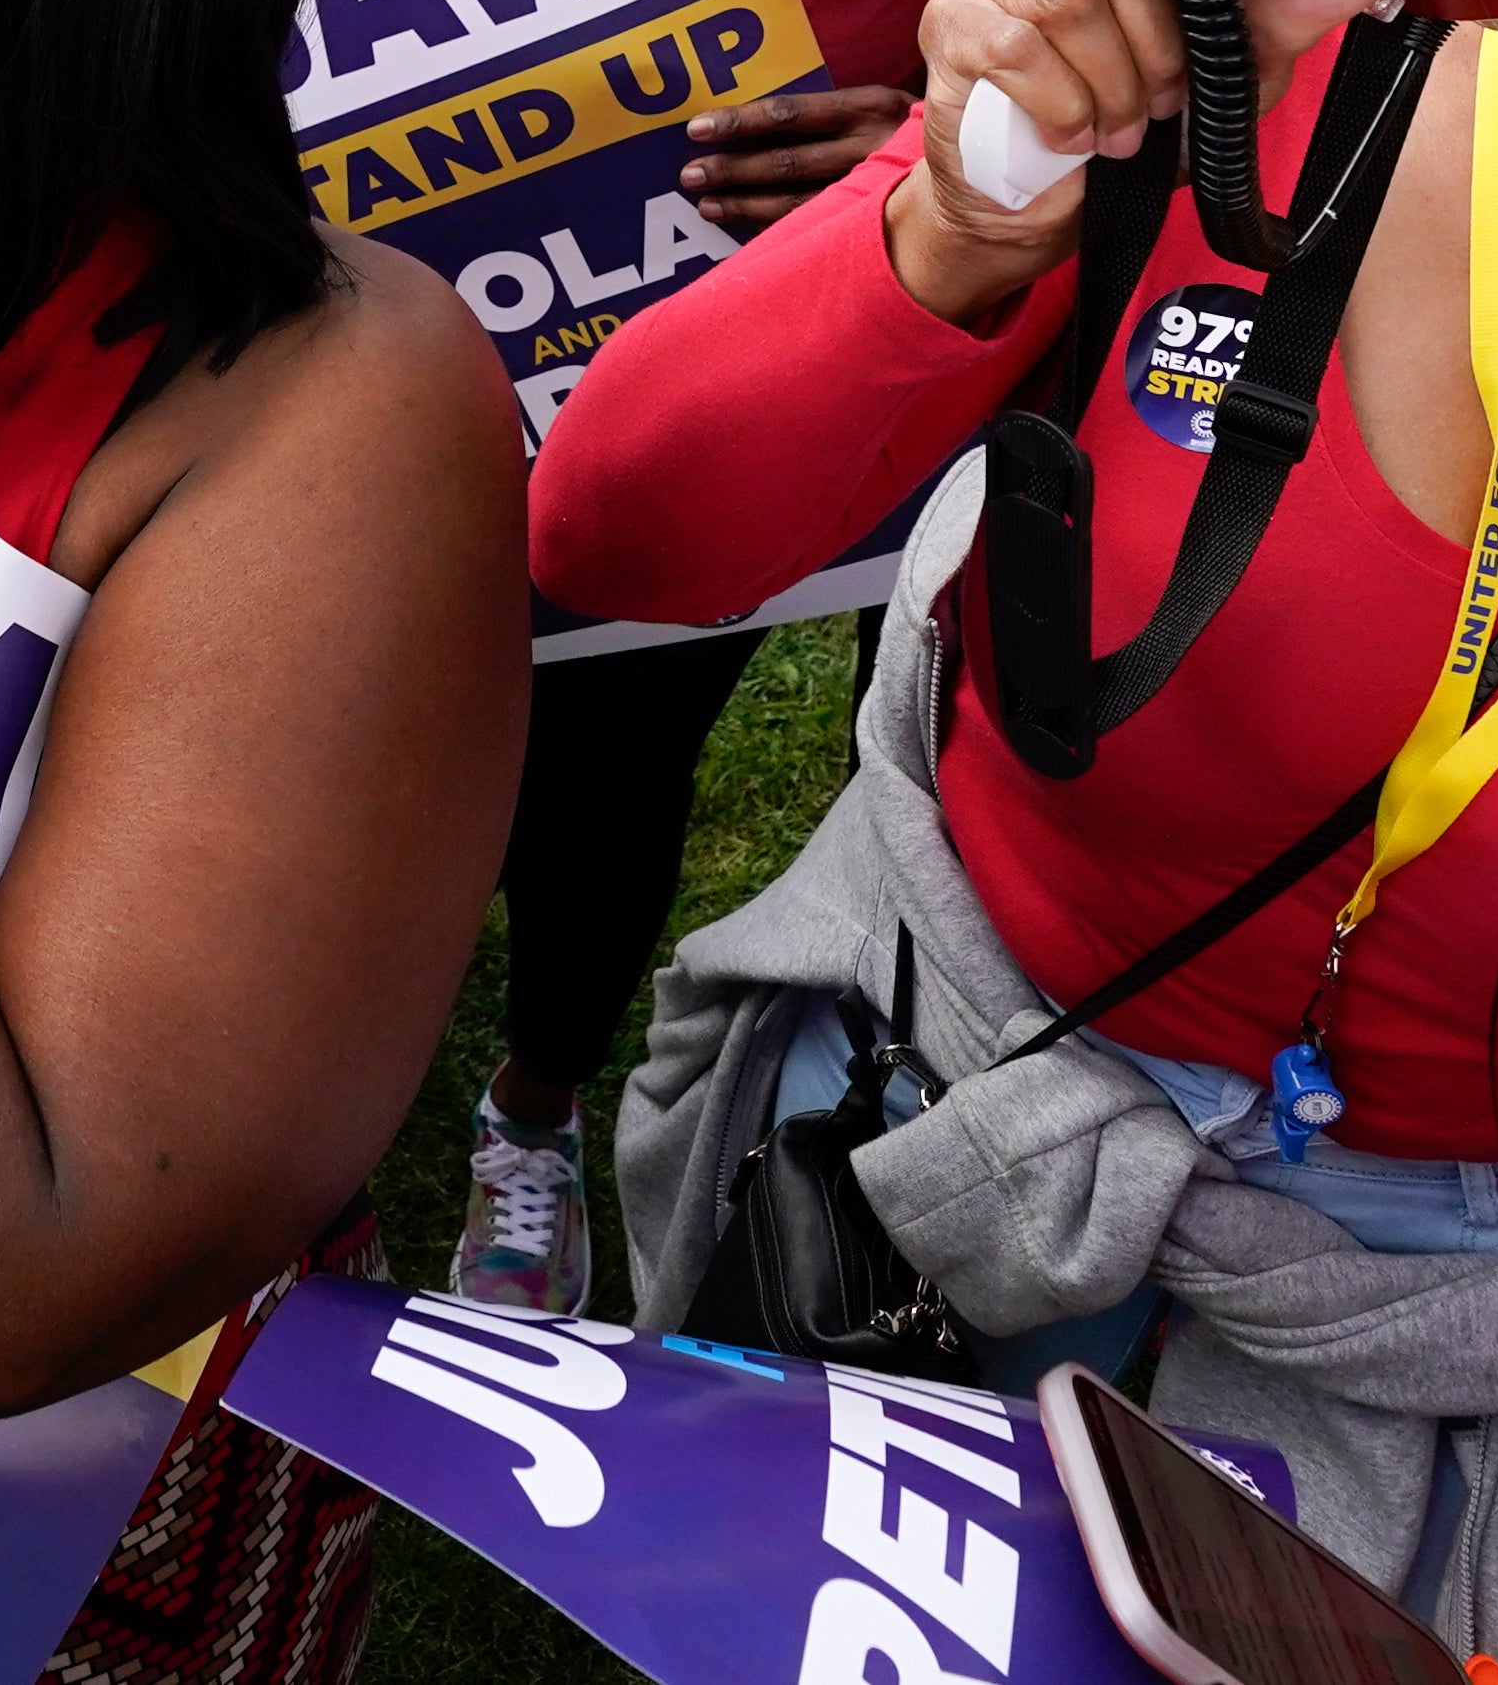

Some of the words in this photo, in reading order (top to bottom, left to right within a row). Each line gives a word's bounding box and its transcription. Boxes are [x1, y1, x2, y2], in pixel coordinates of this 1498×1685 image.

[602, 7, 765, 116] UP
[455, 190, 743, 332] OLA
[535, 313, 624, 366] AND
[1151, 347, 1241, 381] READY
